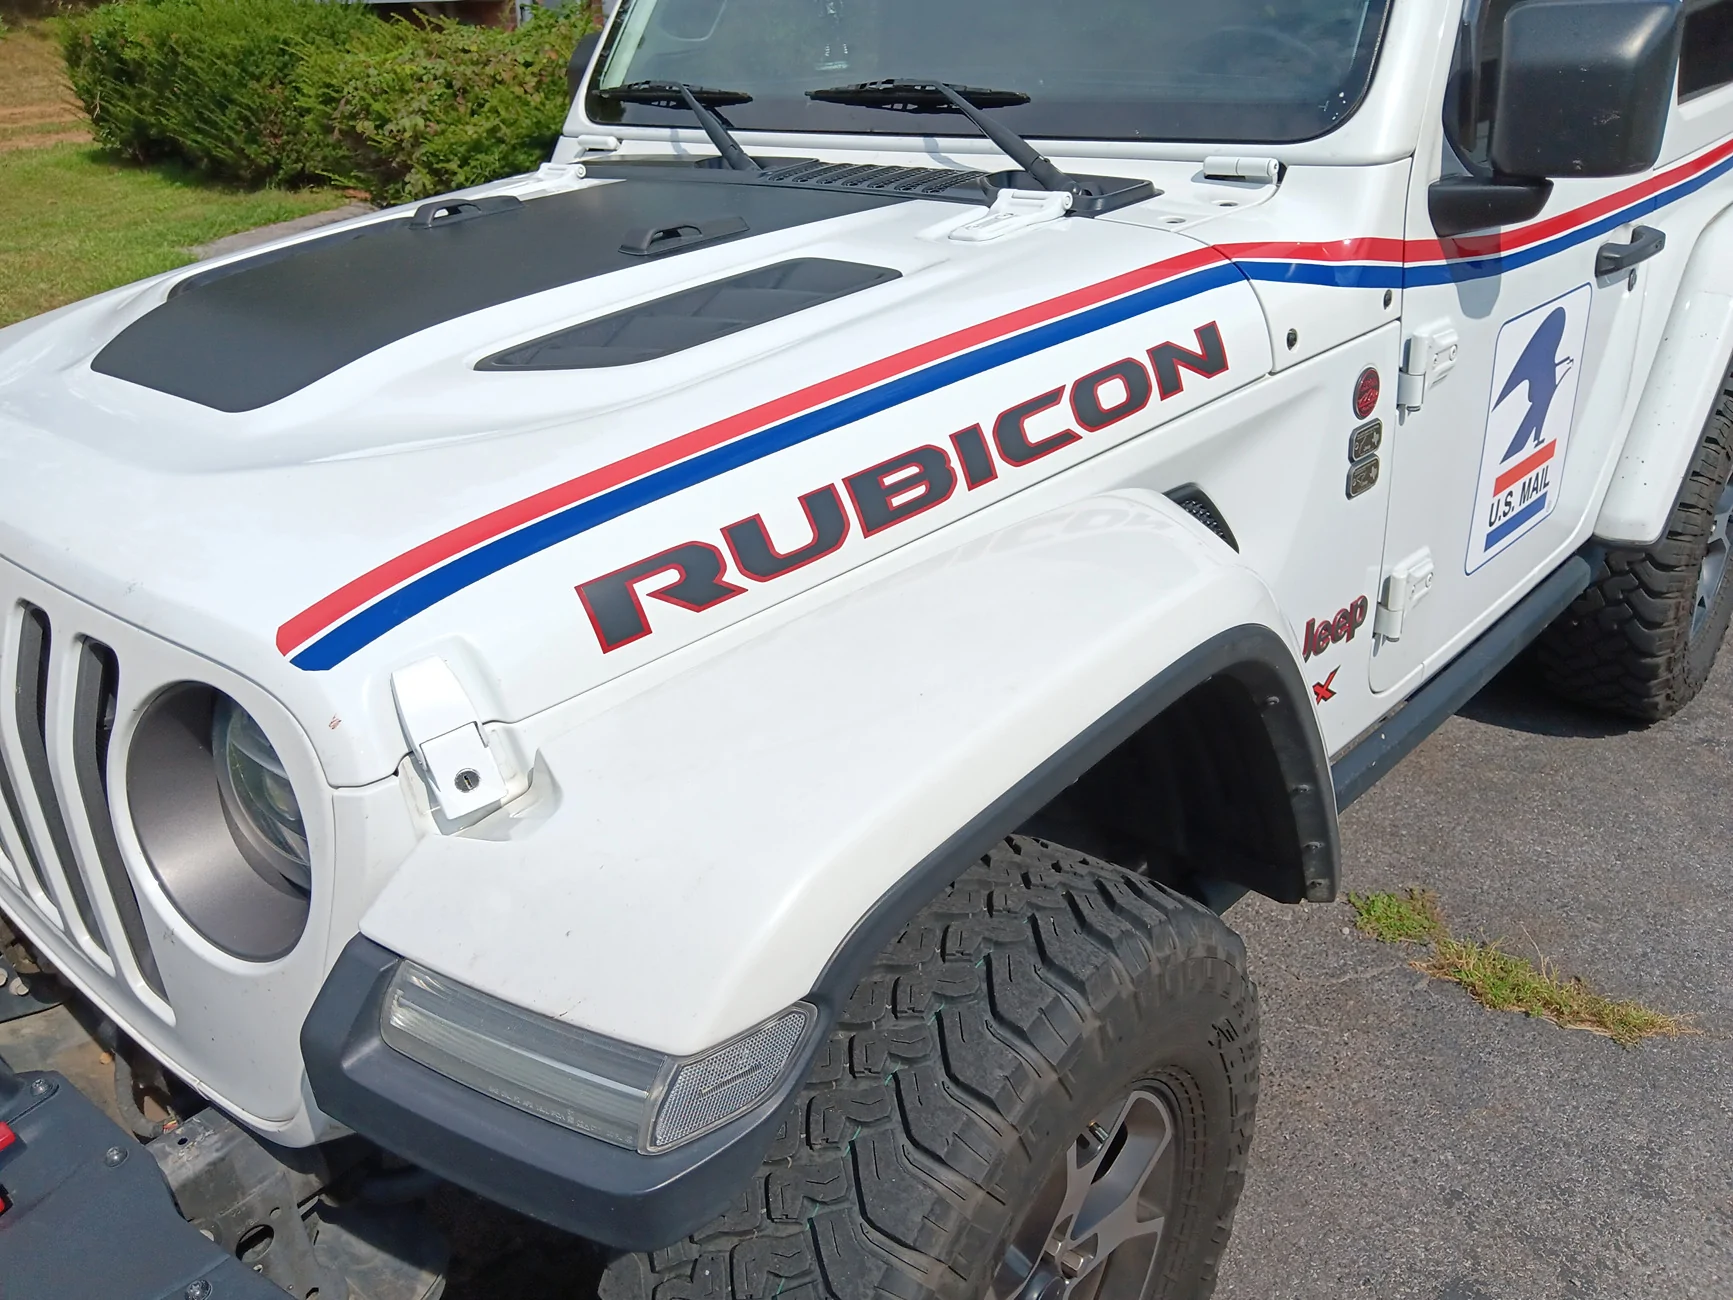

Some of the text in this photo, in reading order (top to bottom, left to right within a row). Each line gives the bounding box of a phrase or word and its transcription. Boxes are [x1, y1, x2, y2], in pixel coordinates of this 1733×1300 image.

[574, 320, 1229, 654] RUBICON
[1488, 464, 1551, 528] U.S. MAIL
[1302, 595, 1368, 663] Jeep
